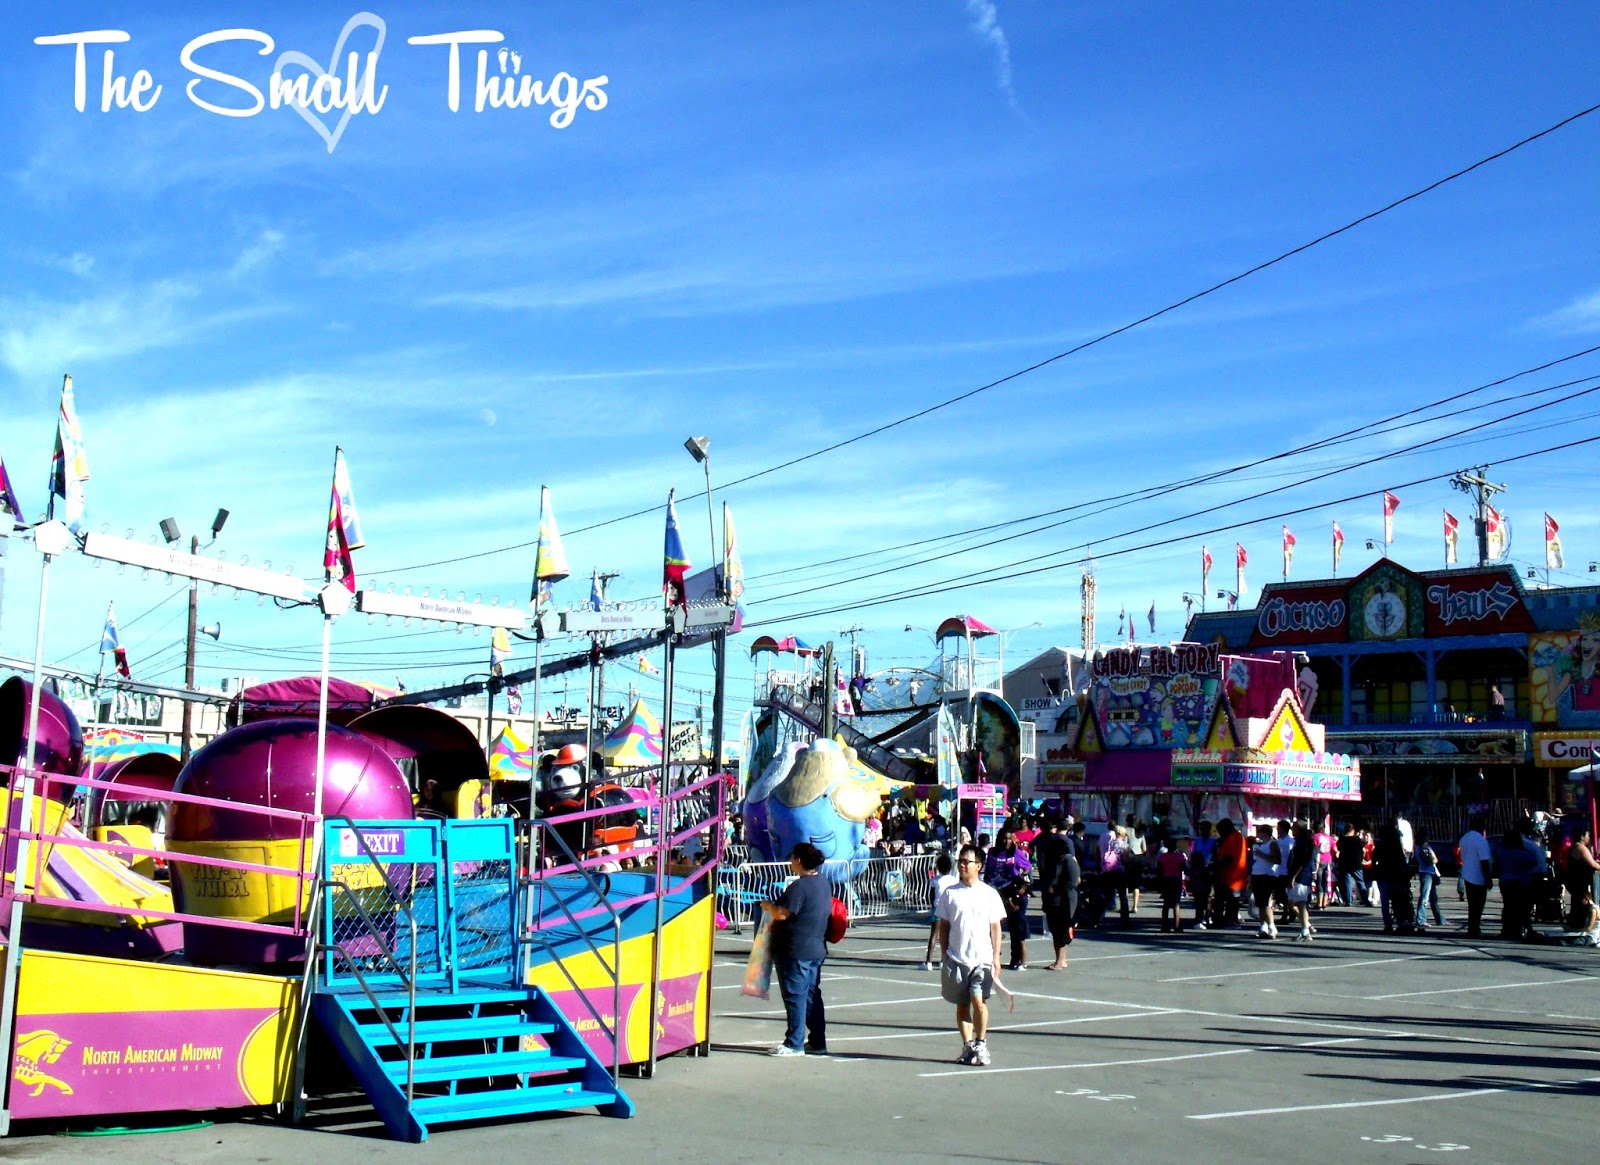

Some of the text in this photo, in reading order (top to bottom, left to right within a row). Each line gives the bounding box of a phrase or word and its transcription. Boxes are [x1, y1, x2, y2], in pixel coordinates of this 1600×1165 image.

[1092, 647, 1142, 679] CANDY
[1149, 642, 1220, 677] FACTORY
[1024, 698, 1050, 708] SHOW
[1547, 740, 1600, 758] Com
[1227, 768, 1275, 786] COLD DRINKS
[1282, 773, 1314, 789] COTTON
[1318, 775, 1346, 791] CANDY
[362, 833, 400, 853] EXIT
[575, 1016, 602, 1032] AMERICA
[82, 1043, 223, 1066] NORTH AMERICAN MIDWAY
[81, 1063, 223, 1076] ENTERTAINMENT
